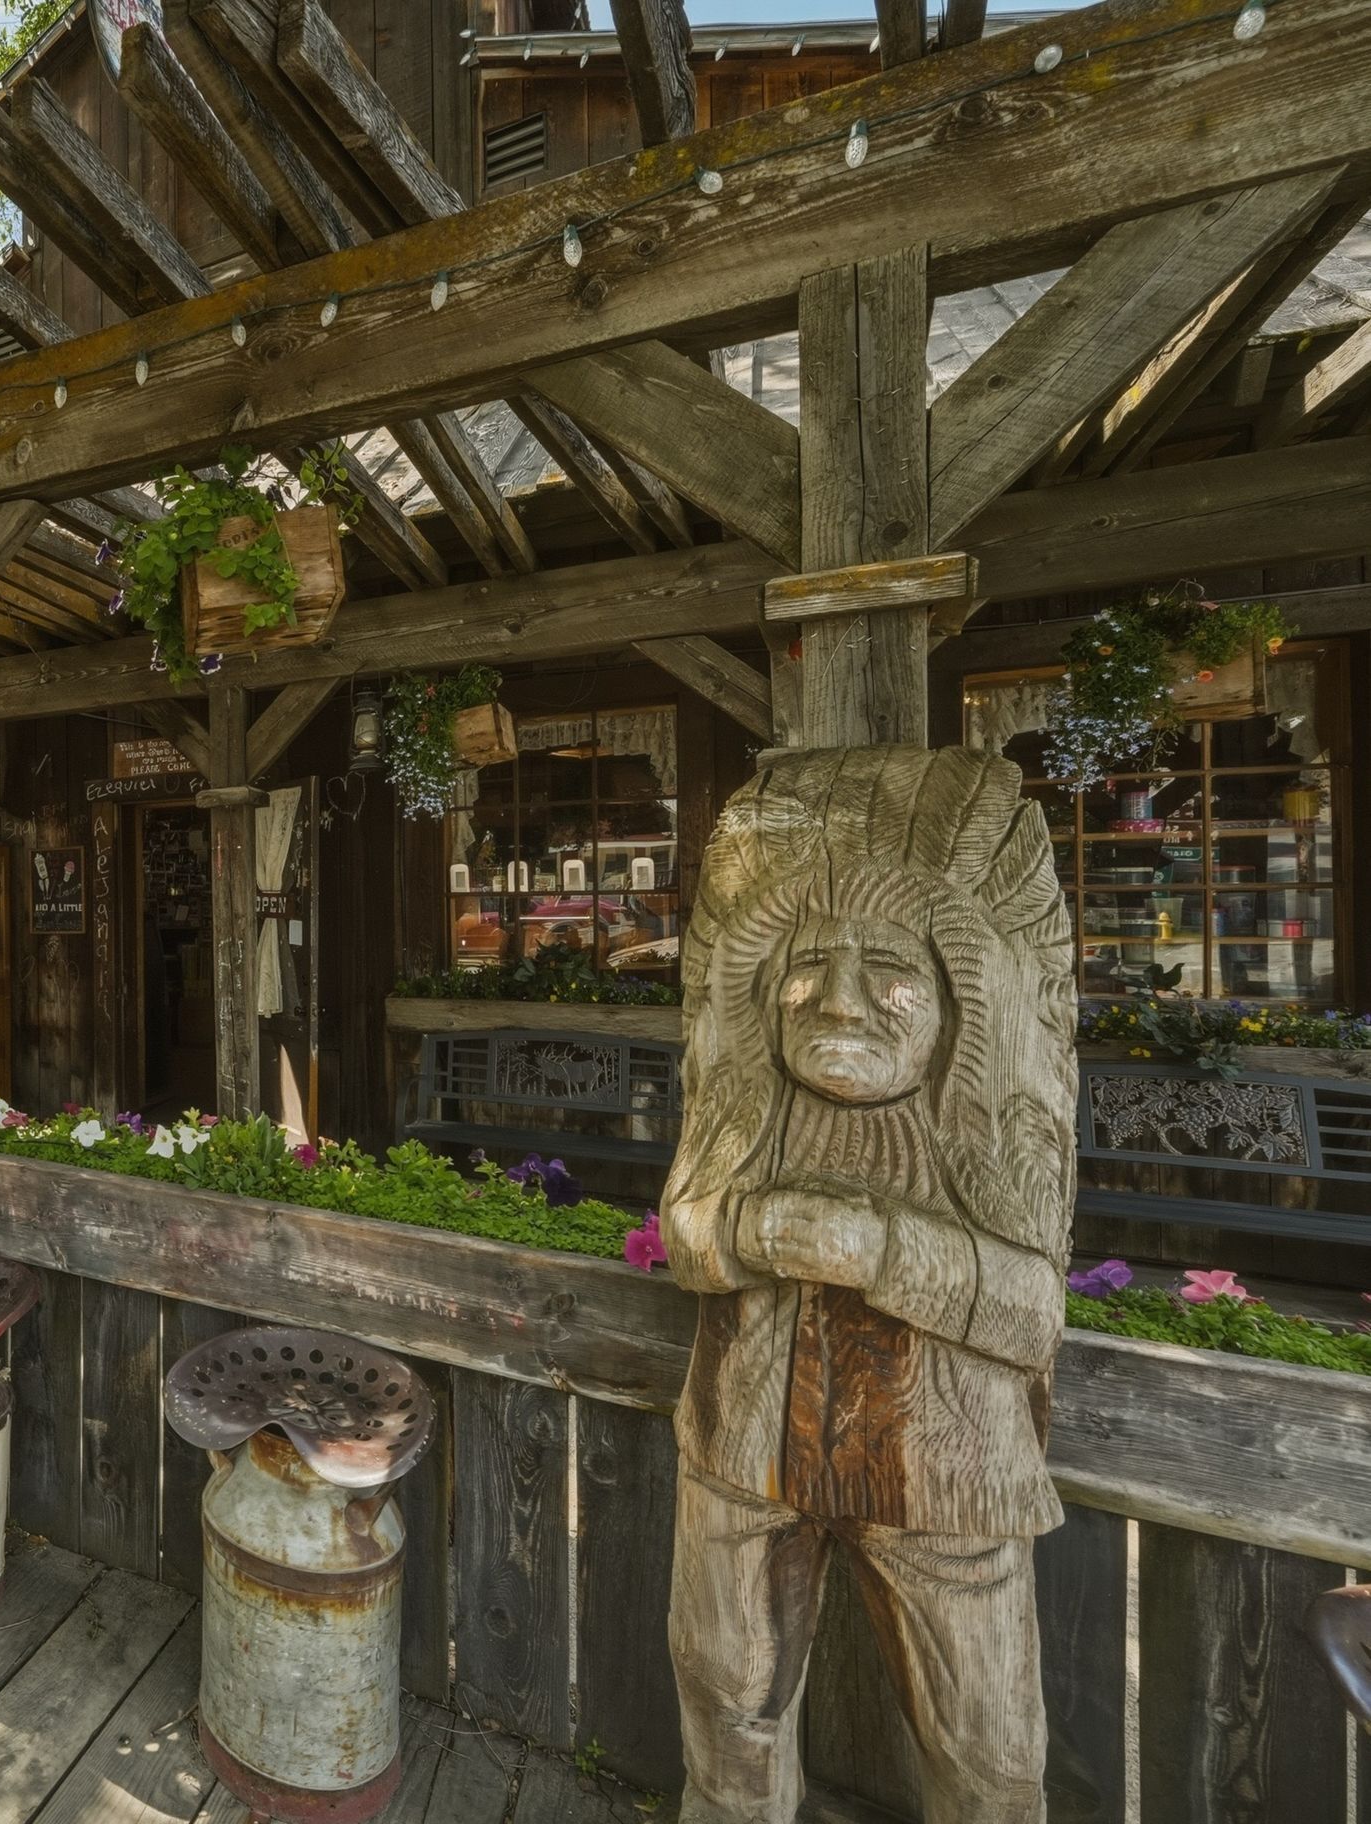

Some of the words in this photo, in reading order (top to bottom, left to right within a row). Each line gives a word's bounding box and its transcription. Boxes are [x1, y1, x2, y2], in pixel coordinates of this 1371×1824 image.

[50, 903, 57, 912] A
[58, 903, 83, 912] LITTLE
[255, 897, 286, 913] OPEN
